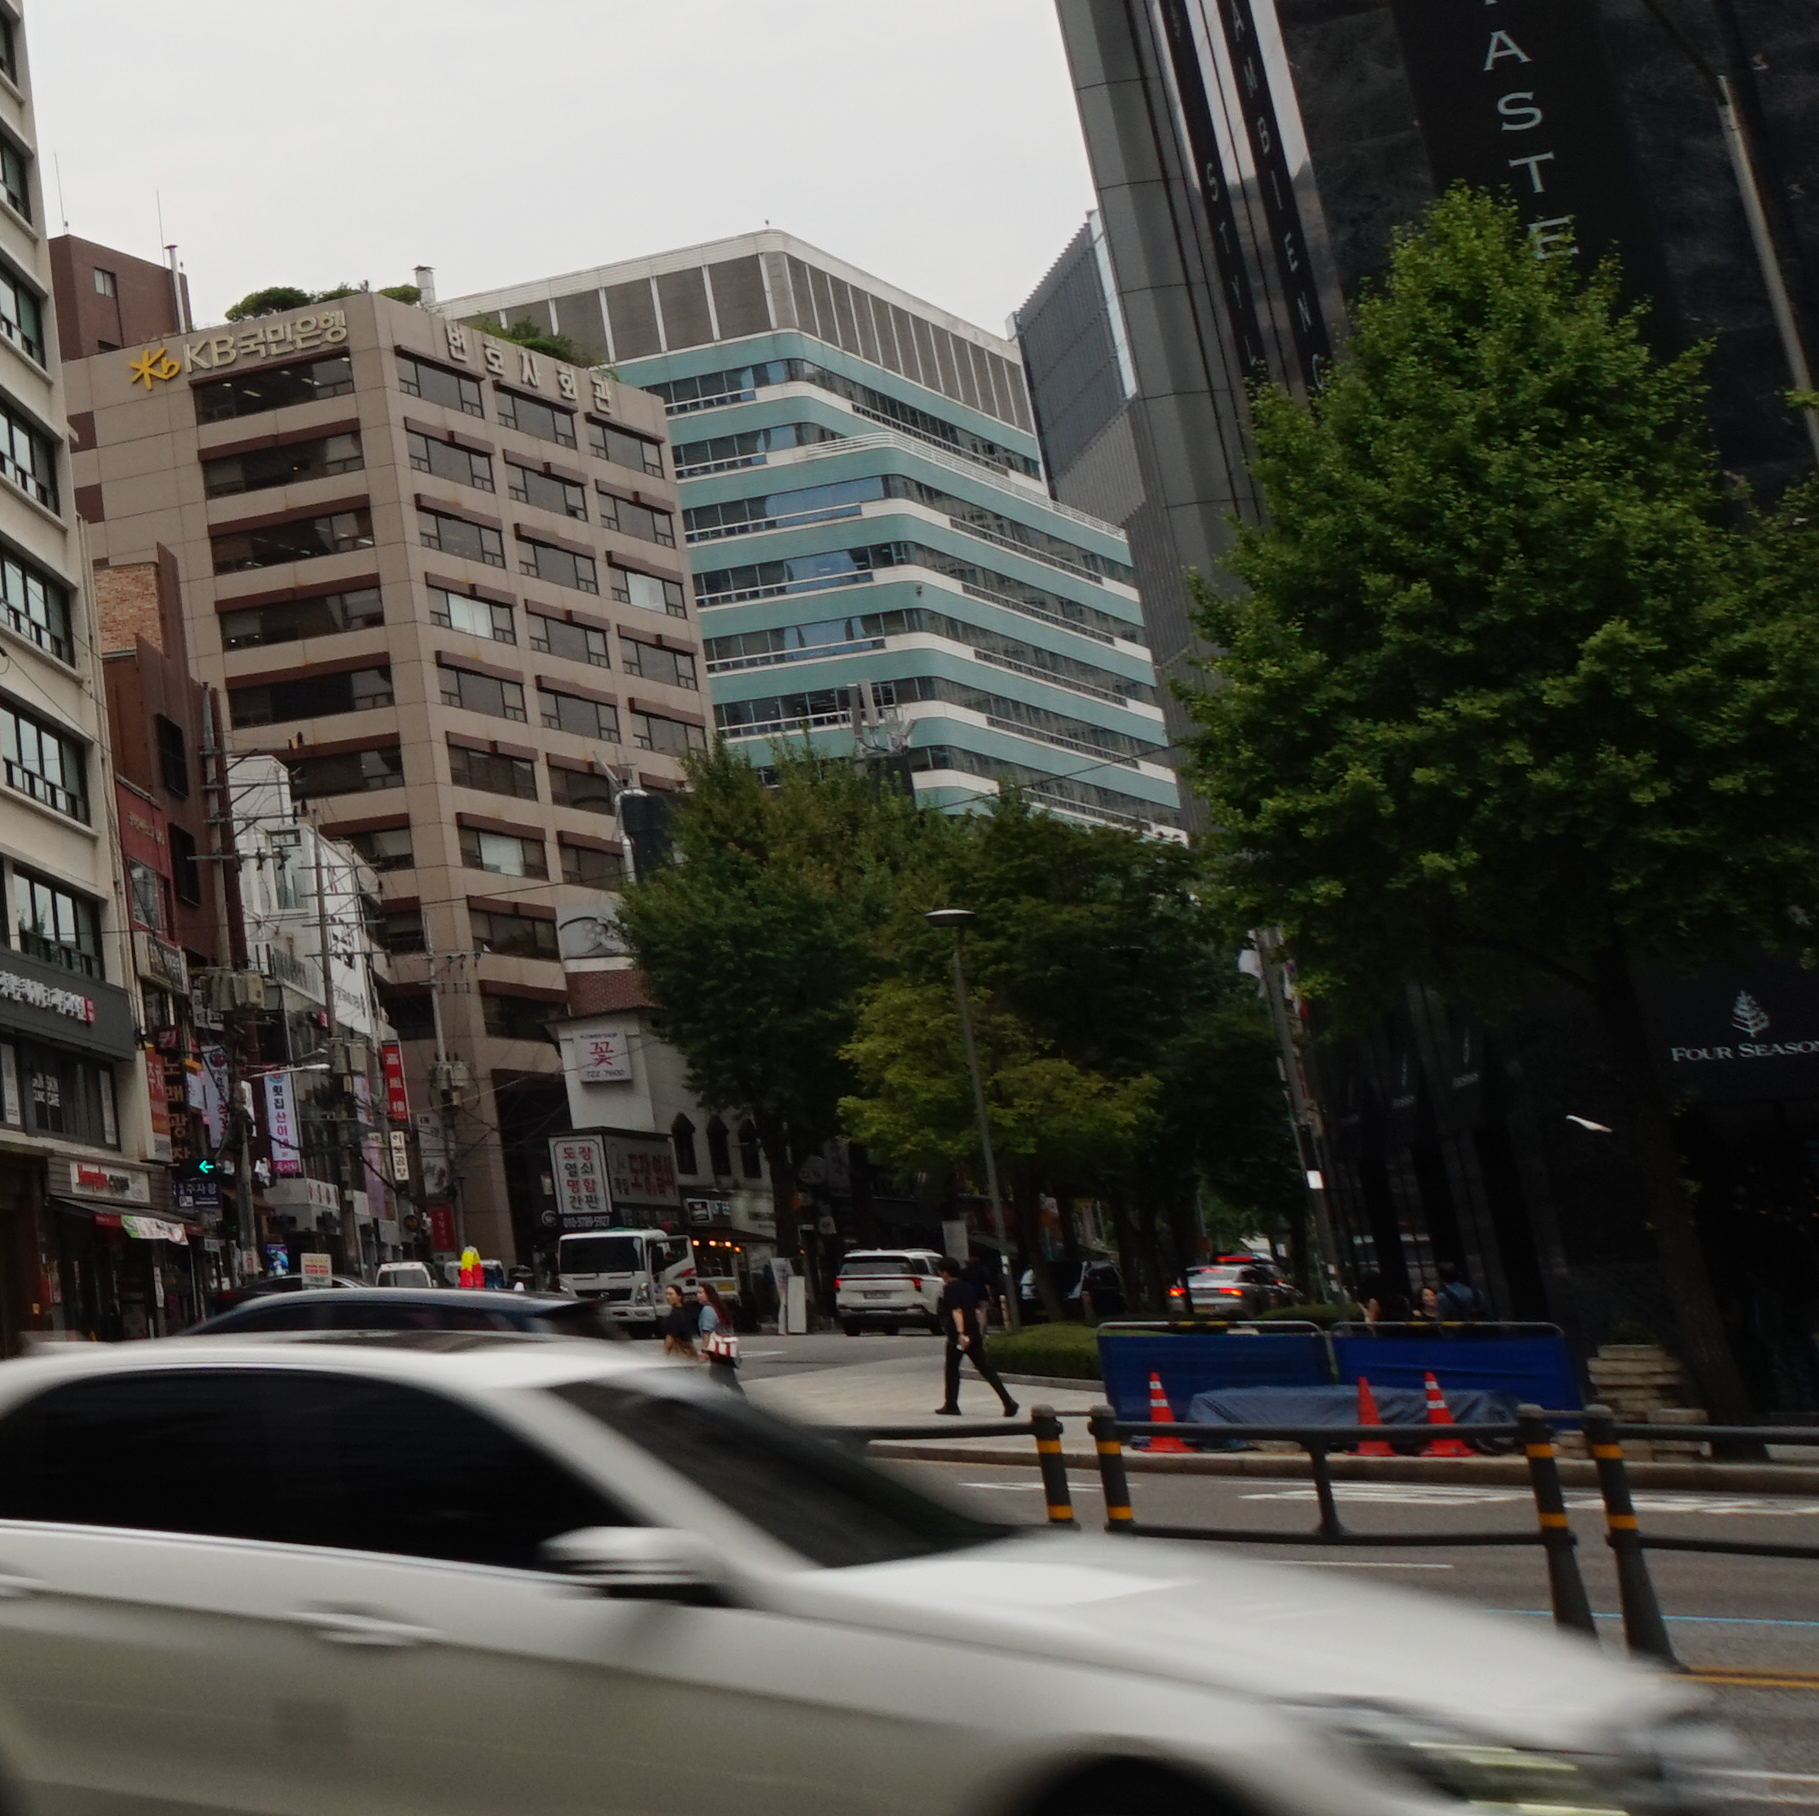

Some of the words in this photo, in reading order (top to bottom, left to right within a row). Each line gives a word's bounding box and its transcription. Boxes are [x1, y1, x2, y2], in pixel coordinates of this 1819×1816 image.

[183, 310, 349, 374] KB국민은행
[447, 322, 613, 415] 변호사회관
[589, 1041, 614, 1067] 꽃
[1670, 1045, 1734, 1062] FOUR
